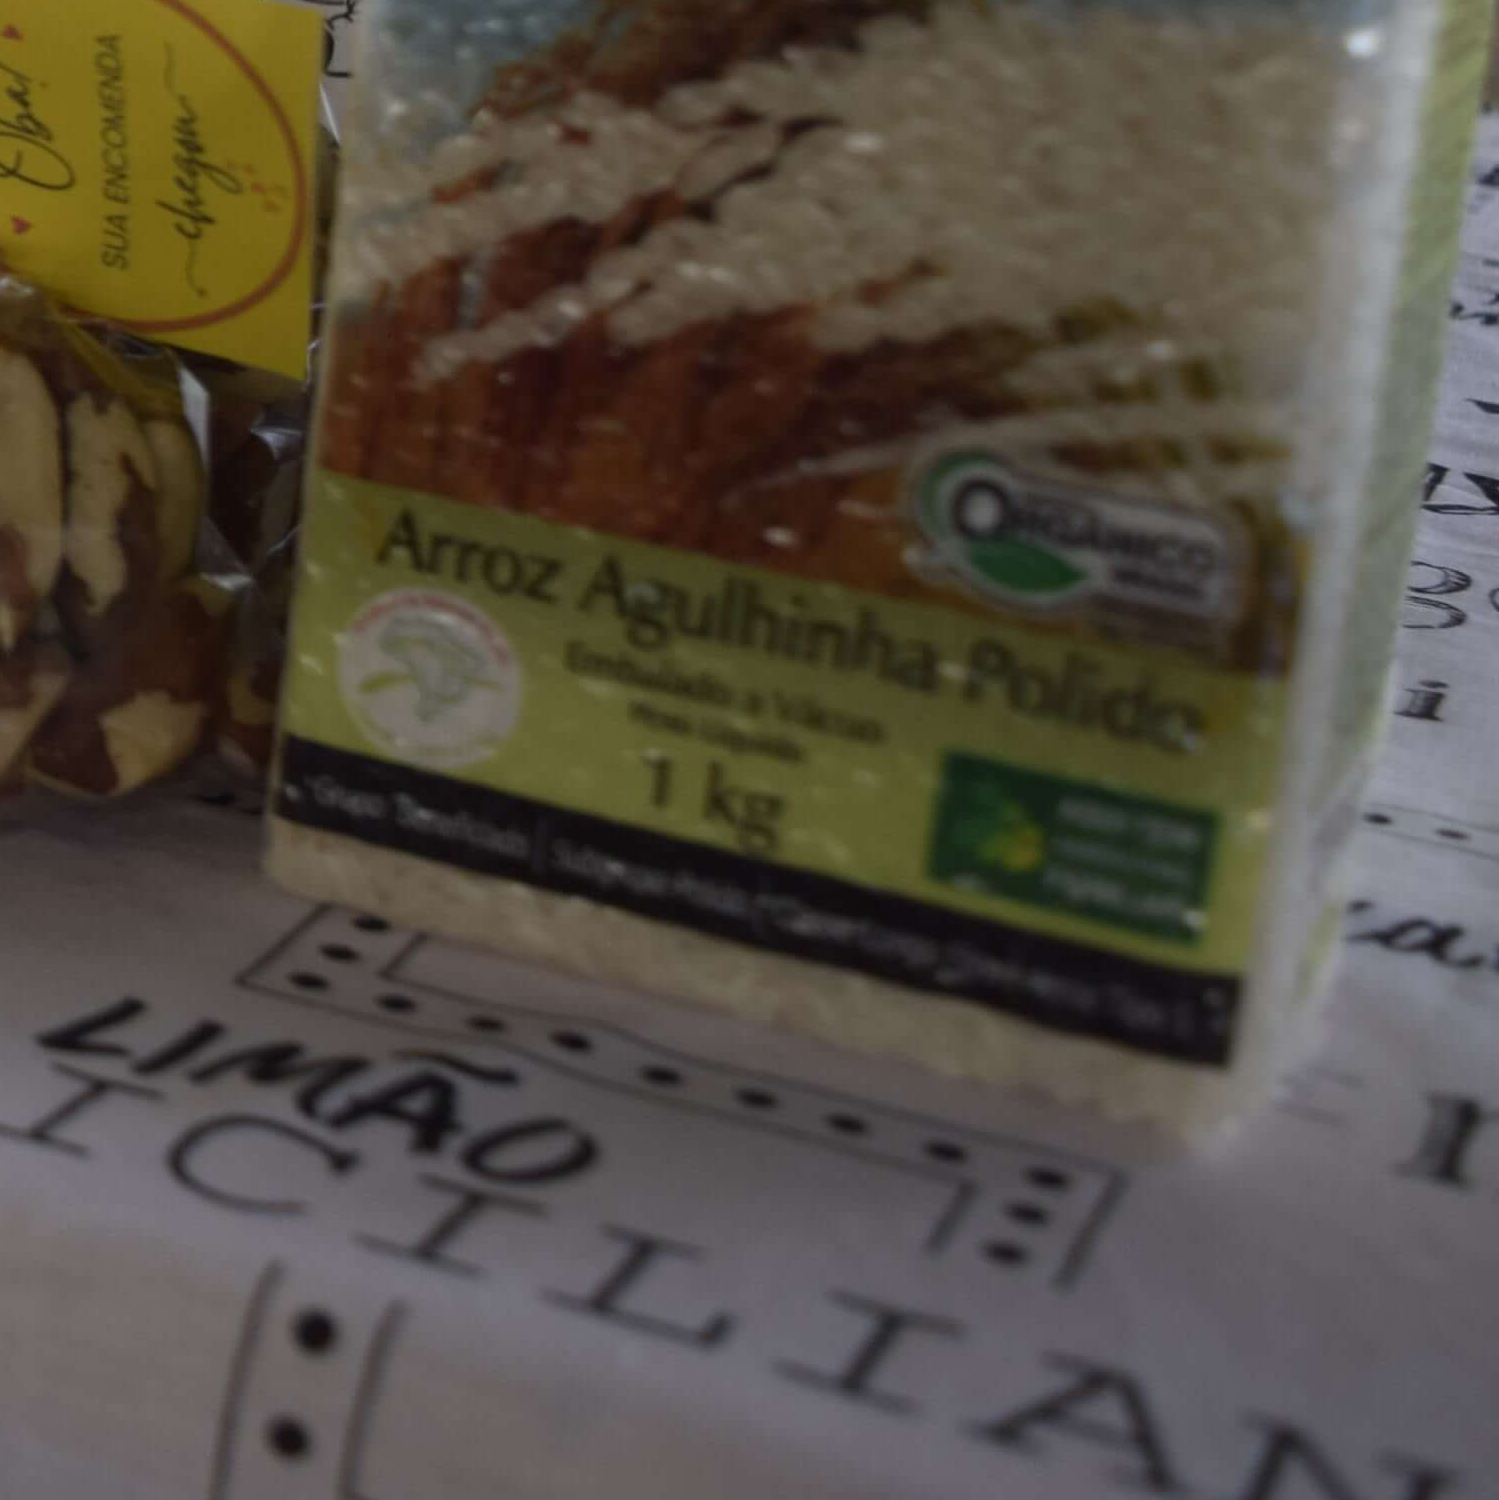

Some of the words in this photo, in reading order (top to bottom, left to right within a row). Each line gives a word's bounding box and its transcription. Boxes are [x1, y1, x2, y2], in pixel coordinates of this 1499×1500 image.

[93, 32, 132, 214] ENCOMENDA
[101, 218, 133, 271] SUA
[374, 510, 563, 607] Arroz
[577, 553, 941, 694] Agulhinha
[643, 754, 671, 808] 1
[705, 759, 785, 849] kg
[36, 996, 603, 1193] LIMÃO
